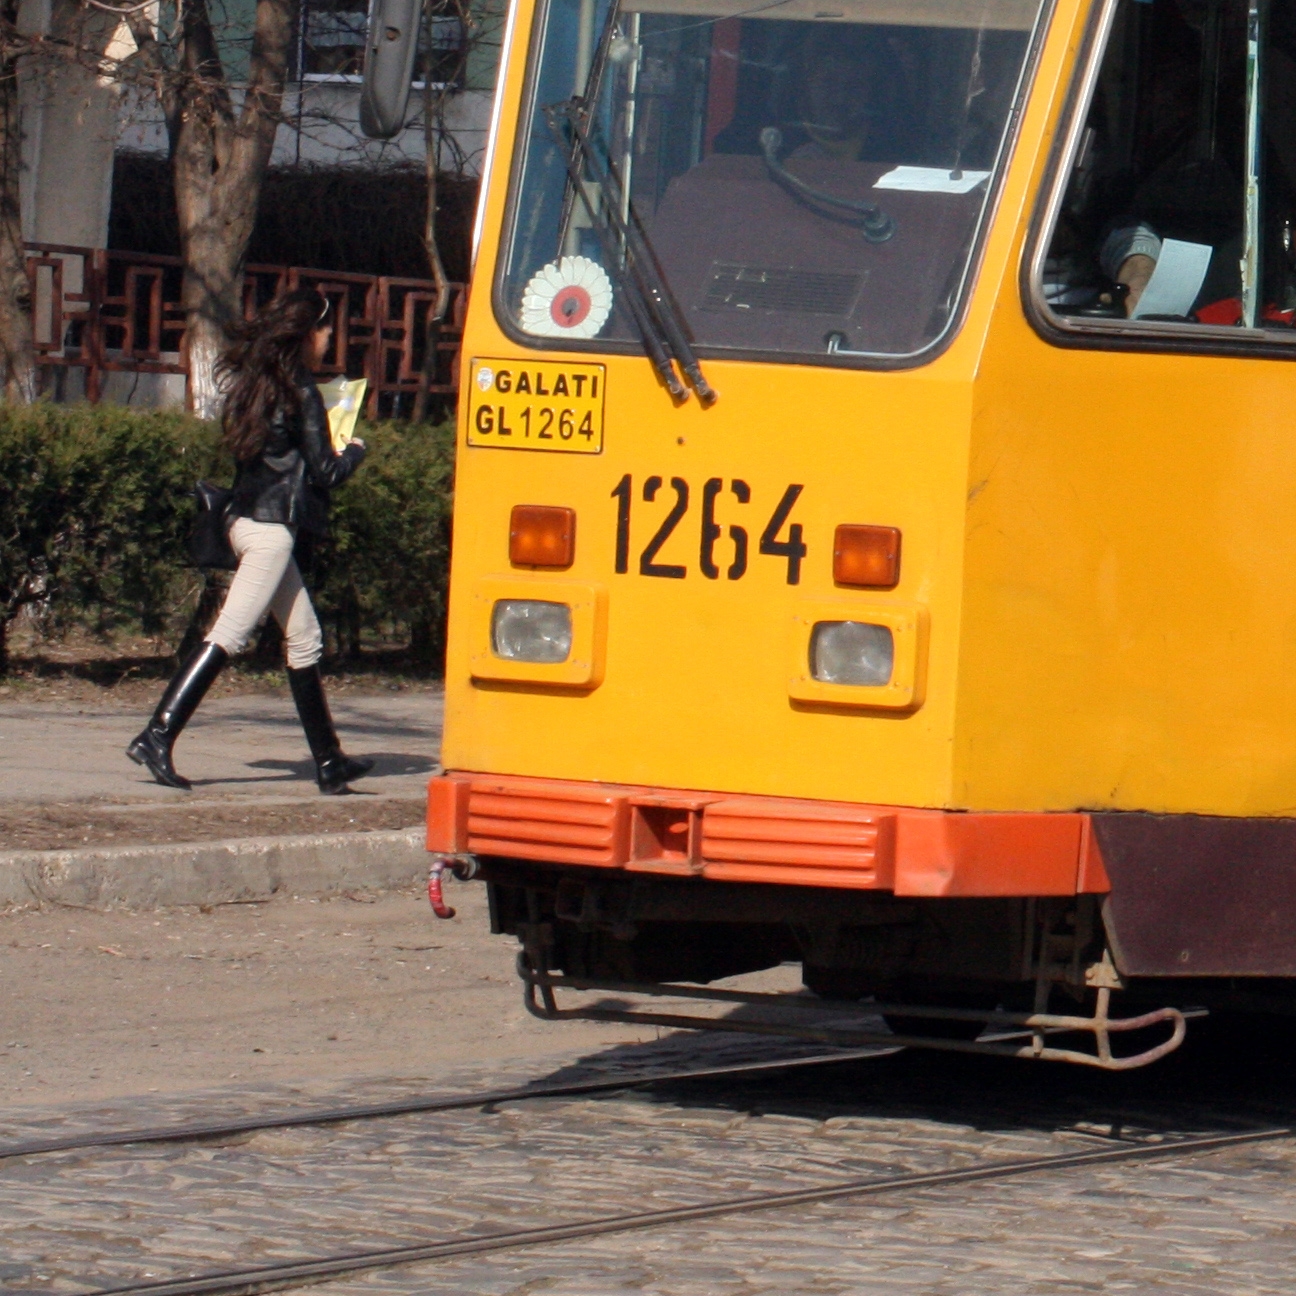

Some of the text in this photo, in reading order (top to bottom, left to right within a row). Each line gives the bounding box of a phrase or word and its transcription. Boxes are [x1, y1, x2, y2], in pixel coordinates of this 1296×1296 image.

[494, 370, 598, 398] GALATI
[476, 404, 594, 442] GL 1264
[610, 473, 808, 586] 1264
